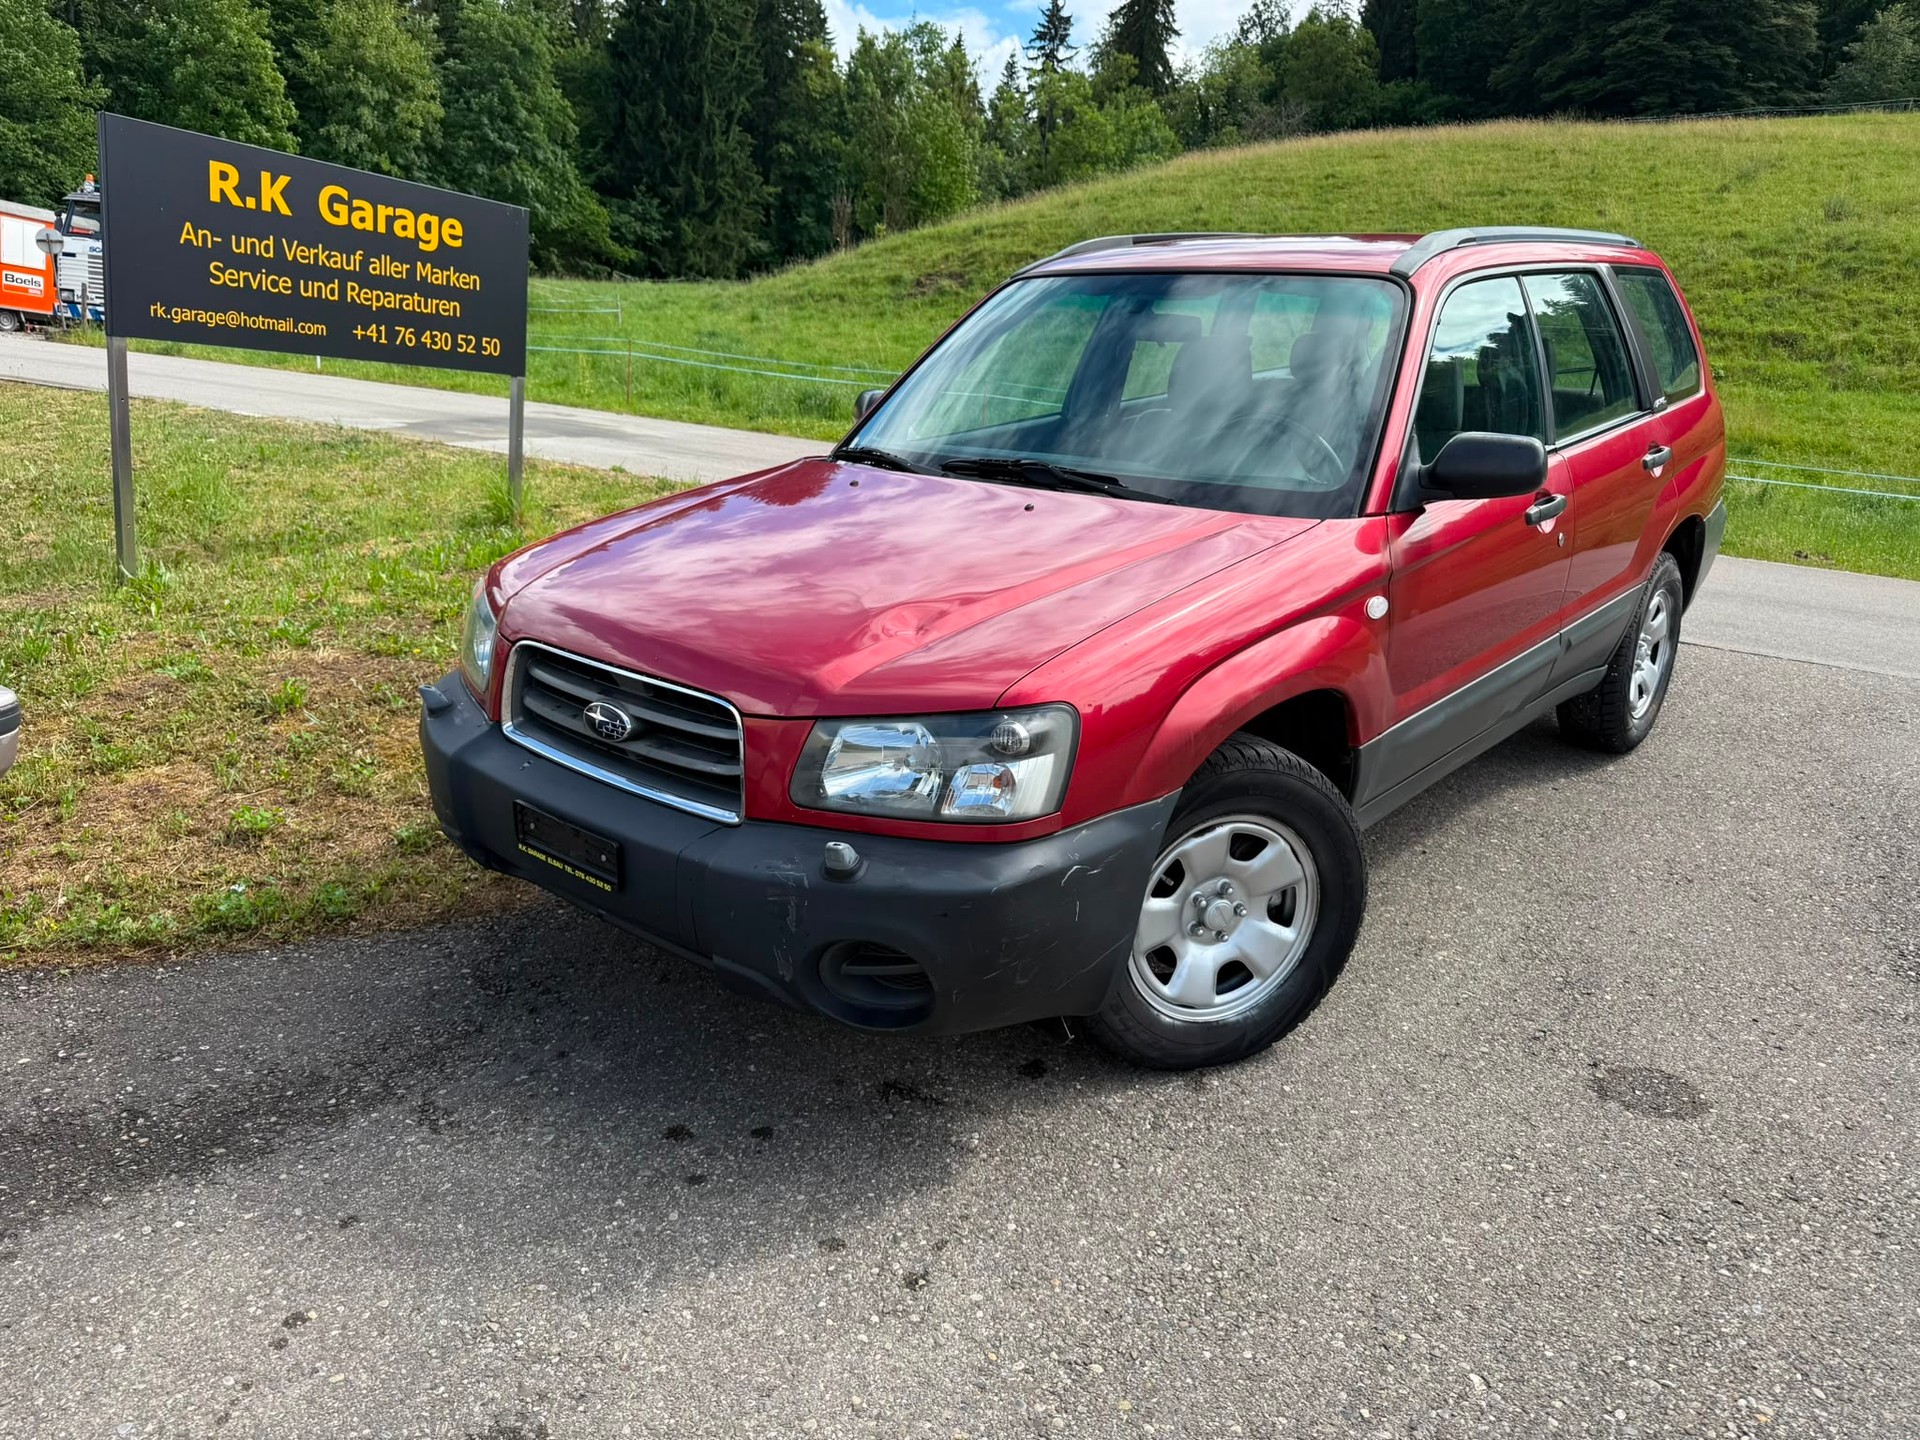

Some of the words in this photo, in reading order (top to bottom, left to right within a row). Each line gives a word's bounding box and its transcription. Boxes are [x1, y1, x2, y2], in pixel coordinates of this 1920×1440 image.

[209, 160, 292, 217] R.K
[319, 185, 464, 252] Garage
[4, 272, 41, 287] Boels
[180, 221, 222, 248] An-
[231, 235, 274, 258] und
[283, 239, 364, 272] Verkauf
[369, 255, 410, 279] aller
[417, 261, 481, 290] Marken
[210, 261, 293, 294] Service
[300, 280, 338, 301] und
[347, 281, 461, 318] Reparaturen
[150, 302, 327, 337] rk.garage@hotmail.com
[352, 322, 387, 344] +41
[396, 326, 416, 347] 76
[421, 329, 452, 351] 430
[458, 333, 477, 354] 52
[482, 336, 501, 356] 50
